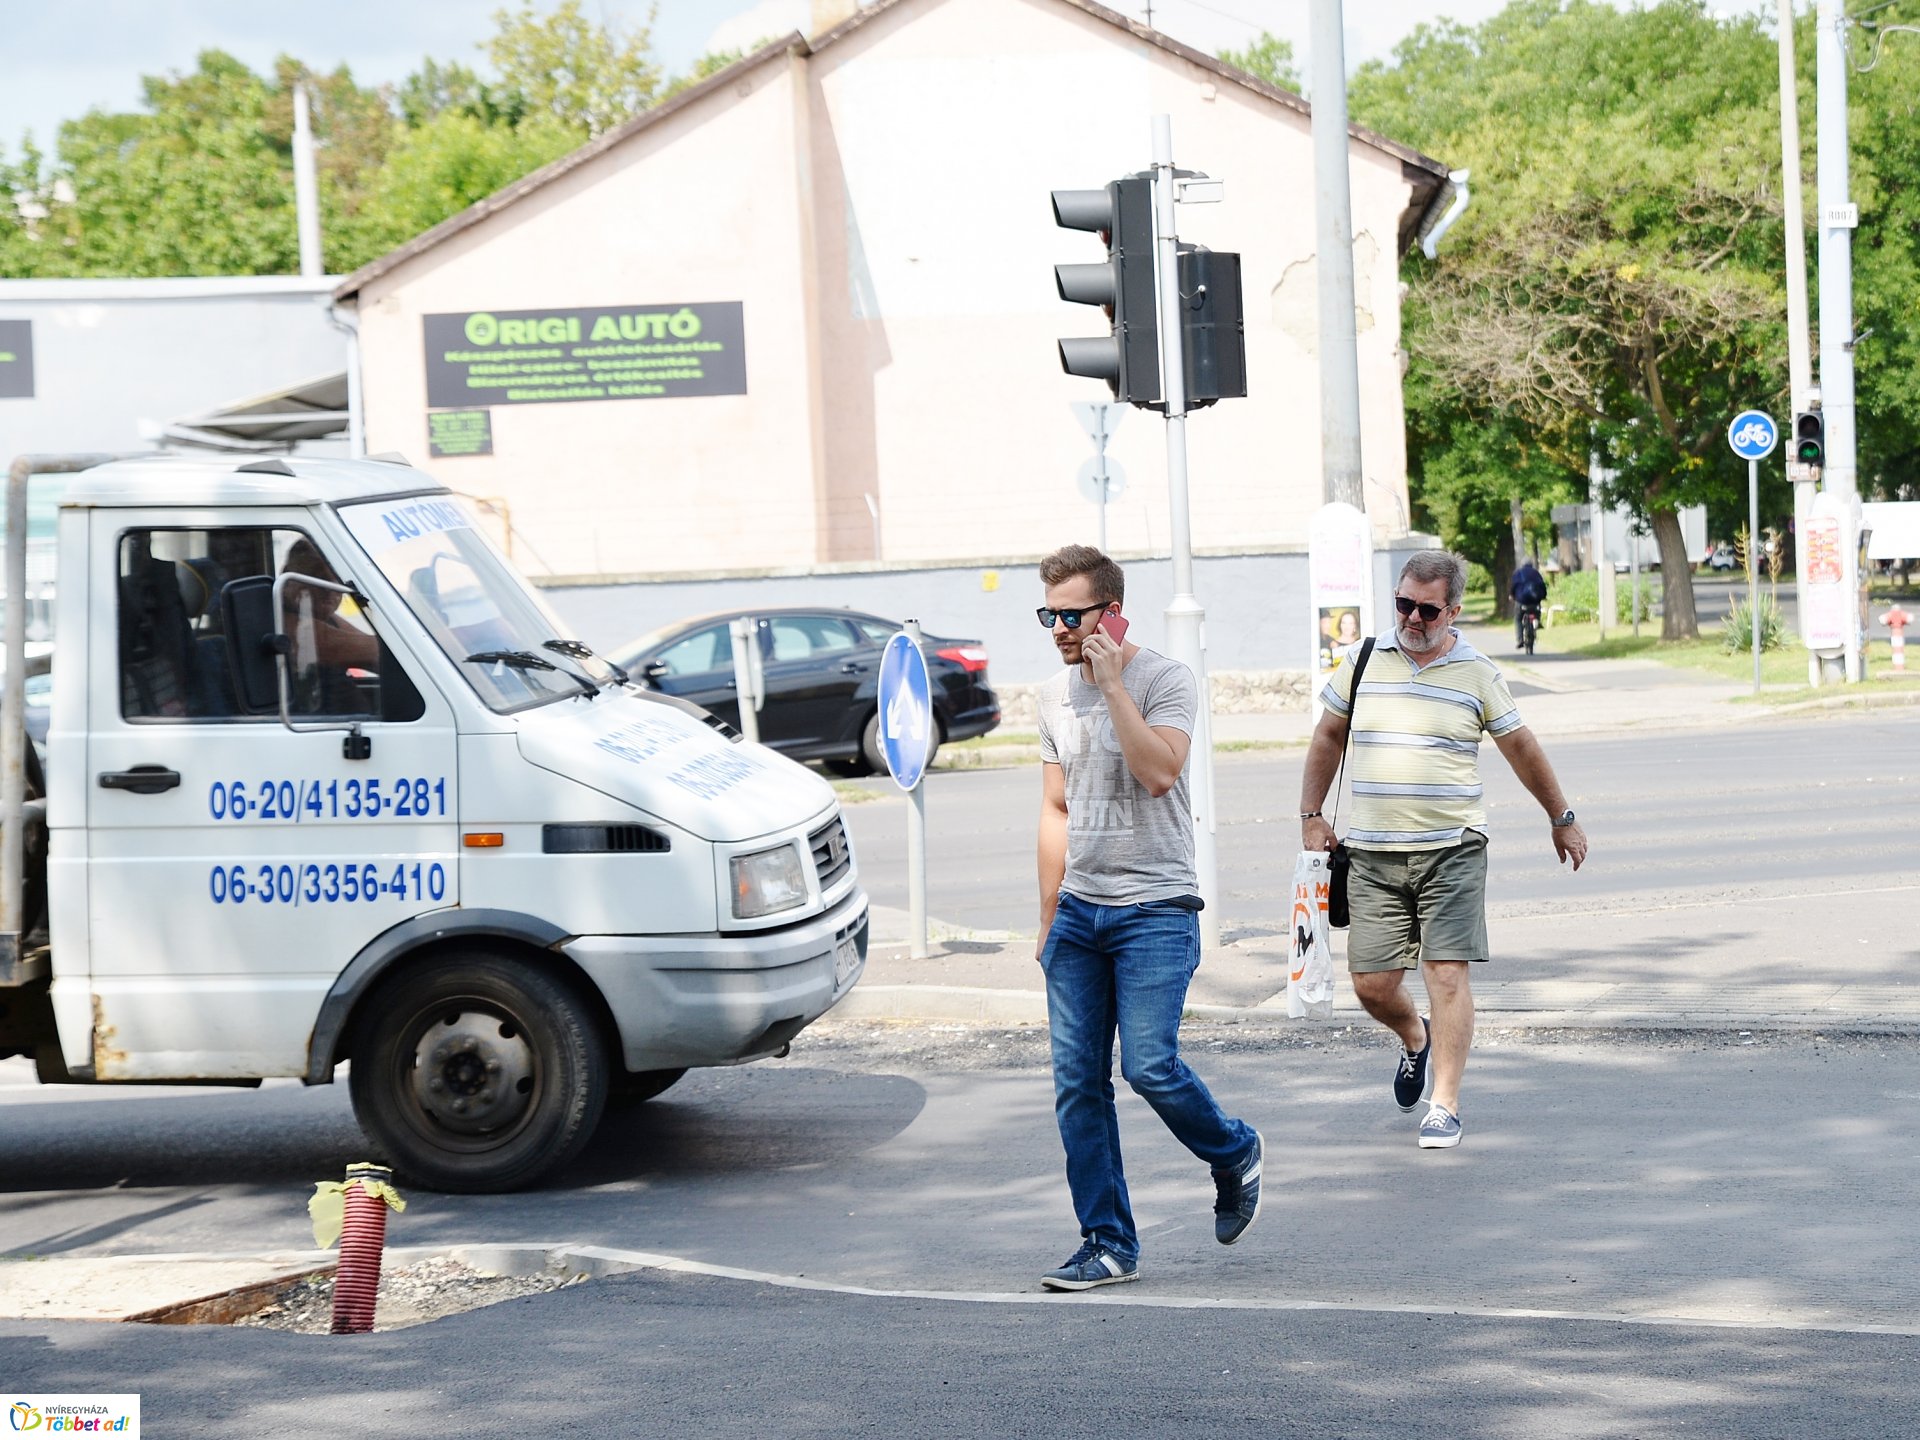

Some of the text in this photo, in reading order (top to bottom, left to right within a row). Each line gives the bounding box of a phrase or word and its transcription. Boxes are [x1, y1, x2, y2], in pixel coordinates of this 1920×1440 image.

[465, 307, 701, 346] ORIGI AUTÓ
[209, 777, 446, 822] 06-20/4135-281
[209, 863, 446, 907] 06-30/3356-410
